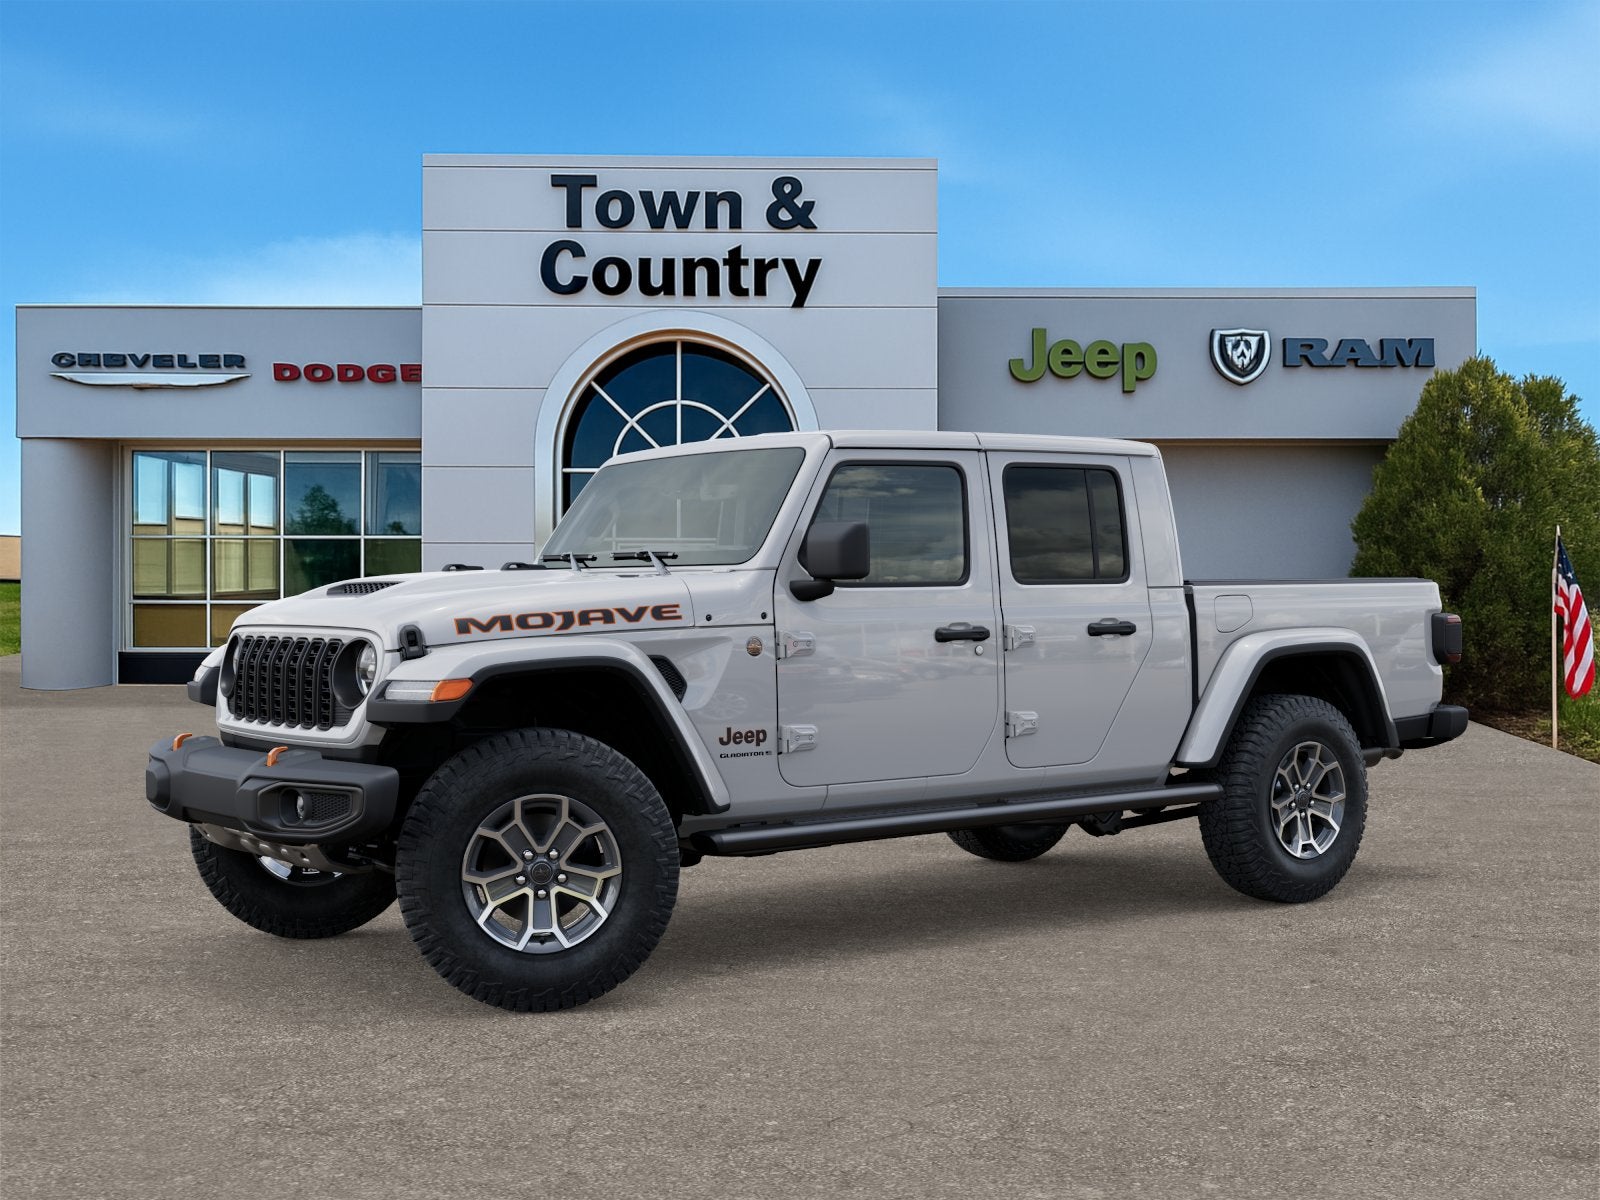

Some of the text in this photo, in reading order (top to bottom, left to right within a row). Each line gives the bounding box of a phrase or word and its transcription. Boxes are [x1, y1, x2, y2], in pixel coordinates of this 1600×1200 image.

[551, 174, 818, 230] Town &
[540, 239, 823, 309] Country
[1008, 328, 1158, 393] Jeep
[1282, 337, 1436, 368] RAM
[273, 363, 422, 383] DODGE
[454, 604, 683, 636] MOJAVE
[718, 727, 768, 747] Jeep
[719, 750, 764, 759] GLADIATOR
